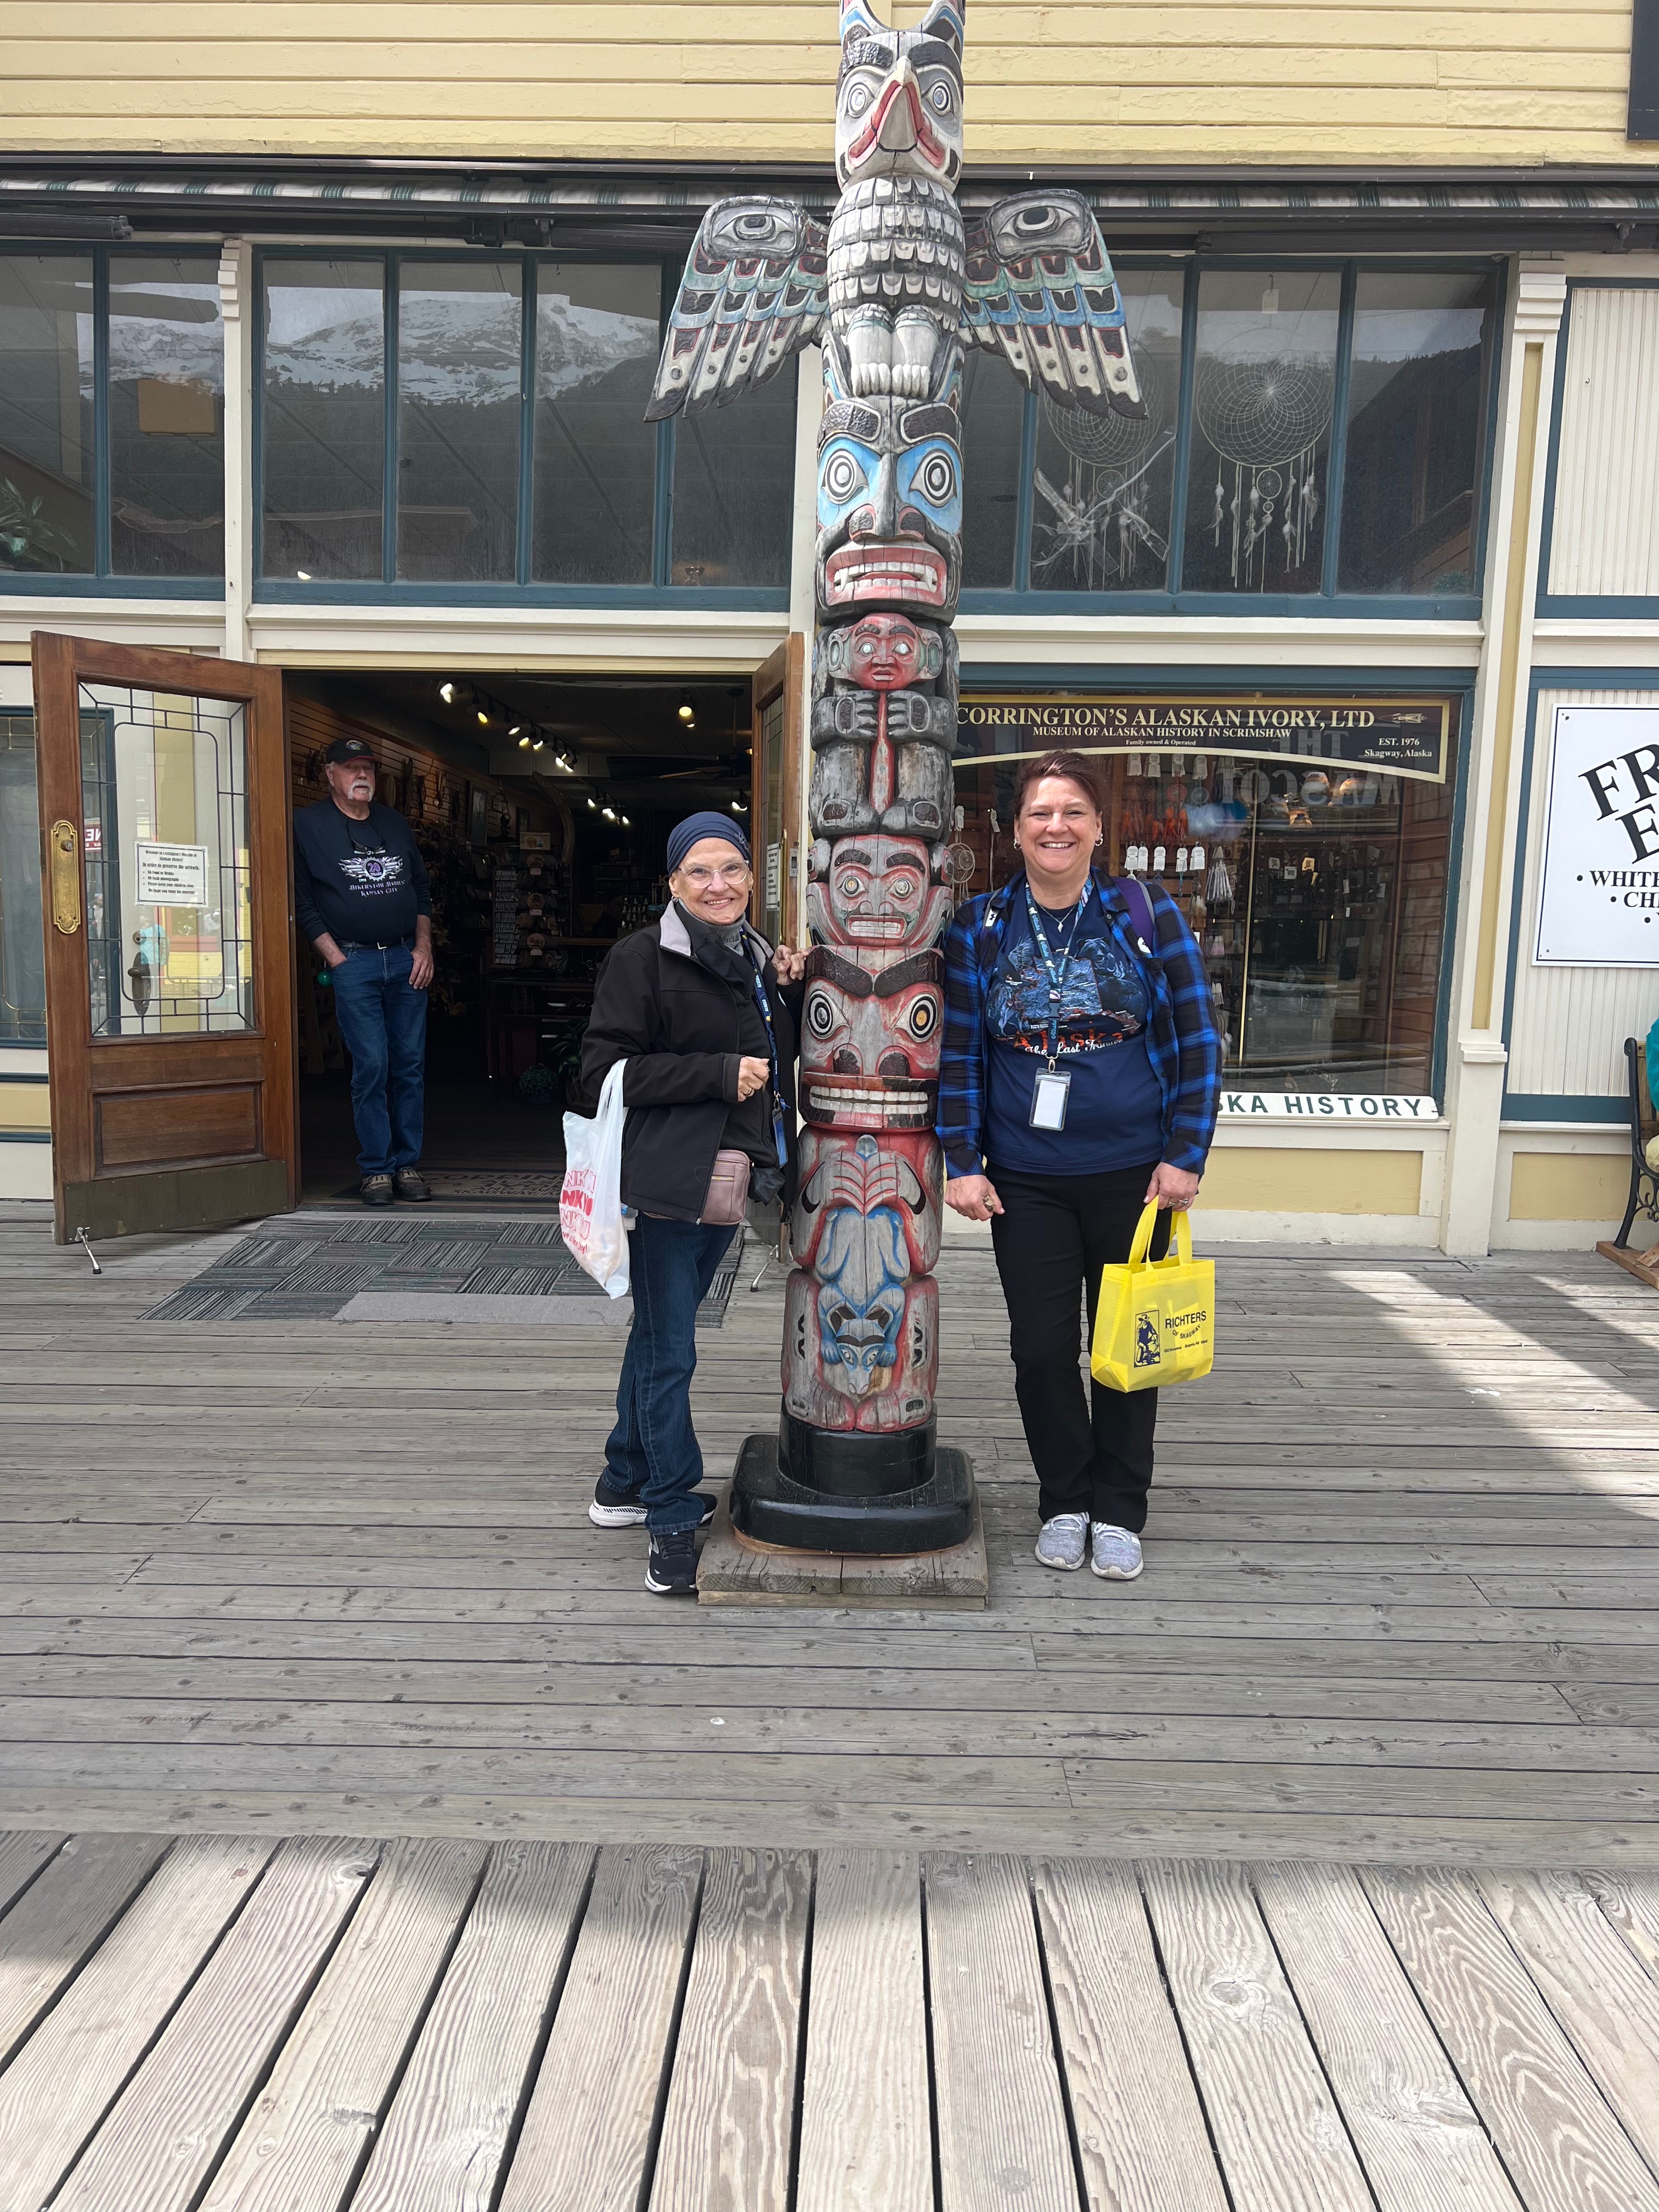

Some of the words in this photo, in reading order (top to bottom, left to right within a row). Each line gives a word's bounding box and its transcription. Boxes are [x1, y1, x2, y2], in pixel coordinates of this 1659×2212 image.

[957, 707, 1127, 726] CORRINGTON'S
[1132, 708, 1242, 727] ALASKAN
[1246, 709, 1325, 730] IVORY,
[1330, 710, 1375, 728] LTD
[1033, 726, 1081, 736] MUSEUM
[1084, 727, 1100, 736] OF
[1101, 727, 1154, 737] ALASKAN
[1156, 727, 1206, 737] HISTORY
[1209, 727, 1221, 737] IN
[1222, 727, 1292, 738] SCRIMSHAW
[1379, 738, 1398, 746] EST.
[1401, 738, 1420, 746] 1976
[1364, 749, 1403, 759] Skagway,
[1404, 749, 1432, 757] Alaska
[367, 862, 381, 872] 20
[1057, 1042, 1080, 1054] Last
[1284, 1096, 1421, 1116] HISTORY
[1165, 1311, 1206, 1329] RICHTERS
[1180, 1324, 1200, 1339] SKAGWAY
